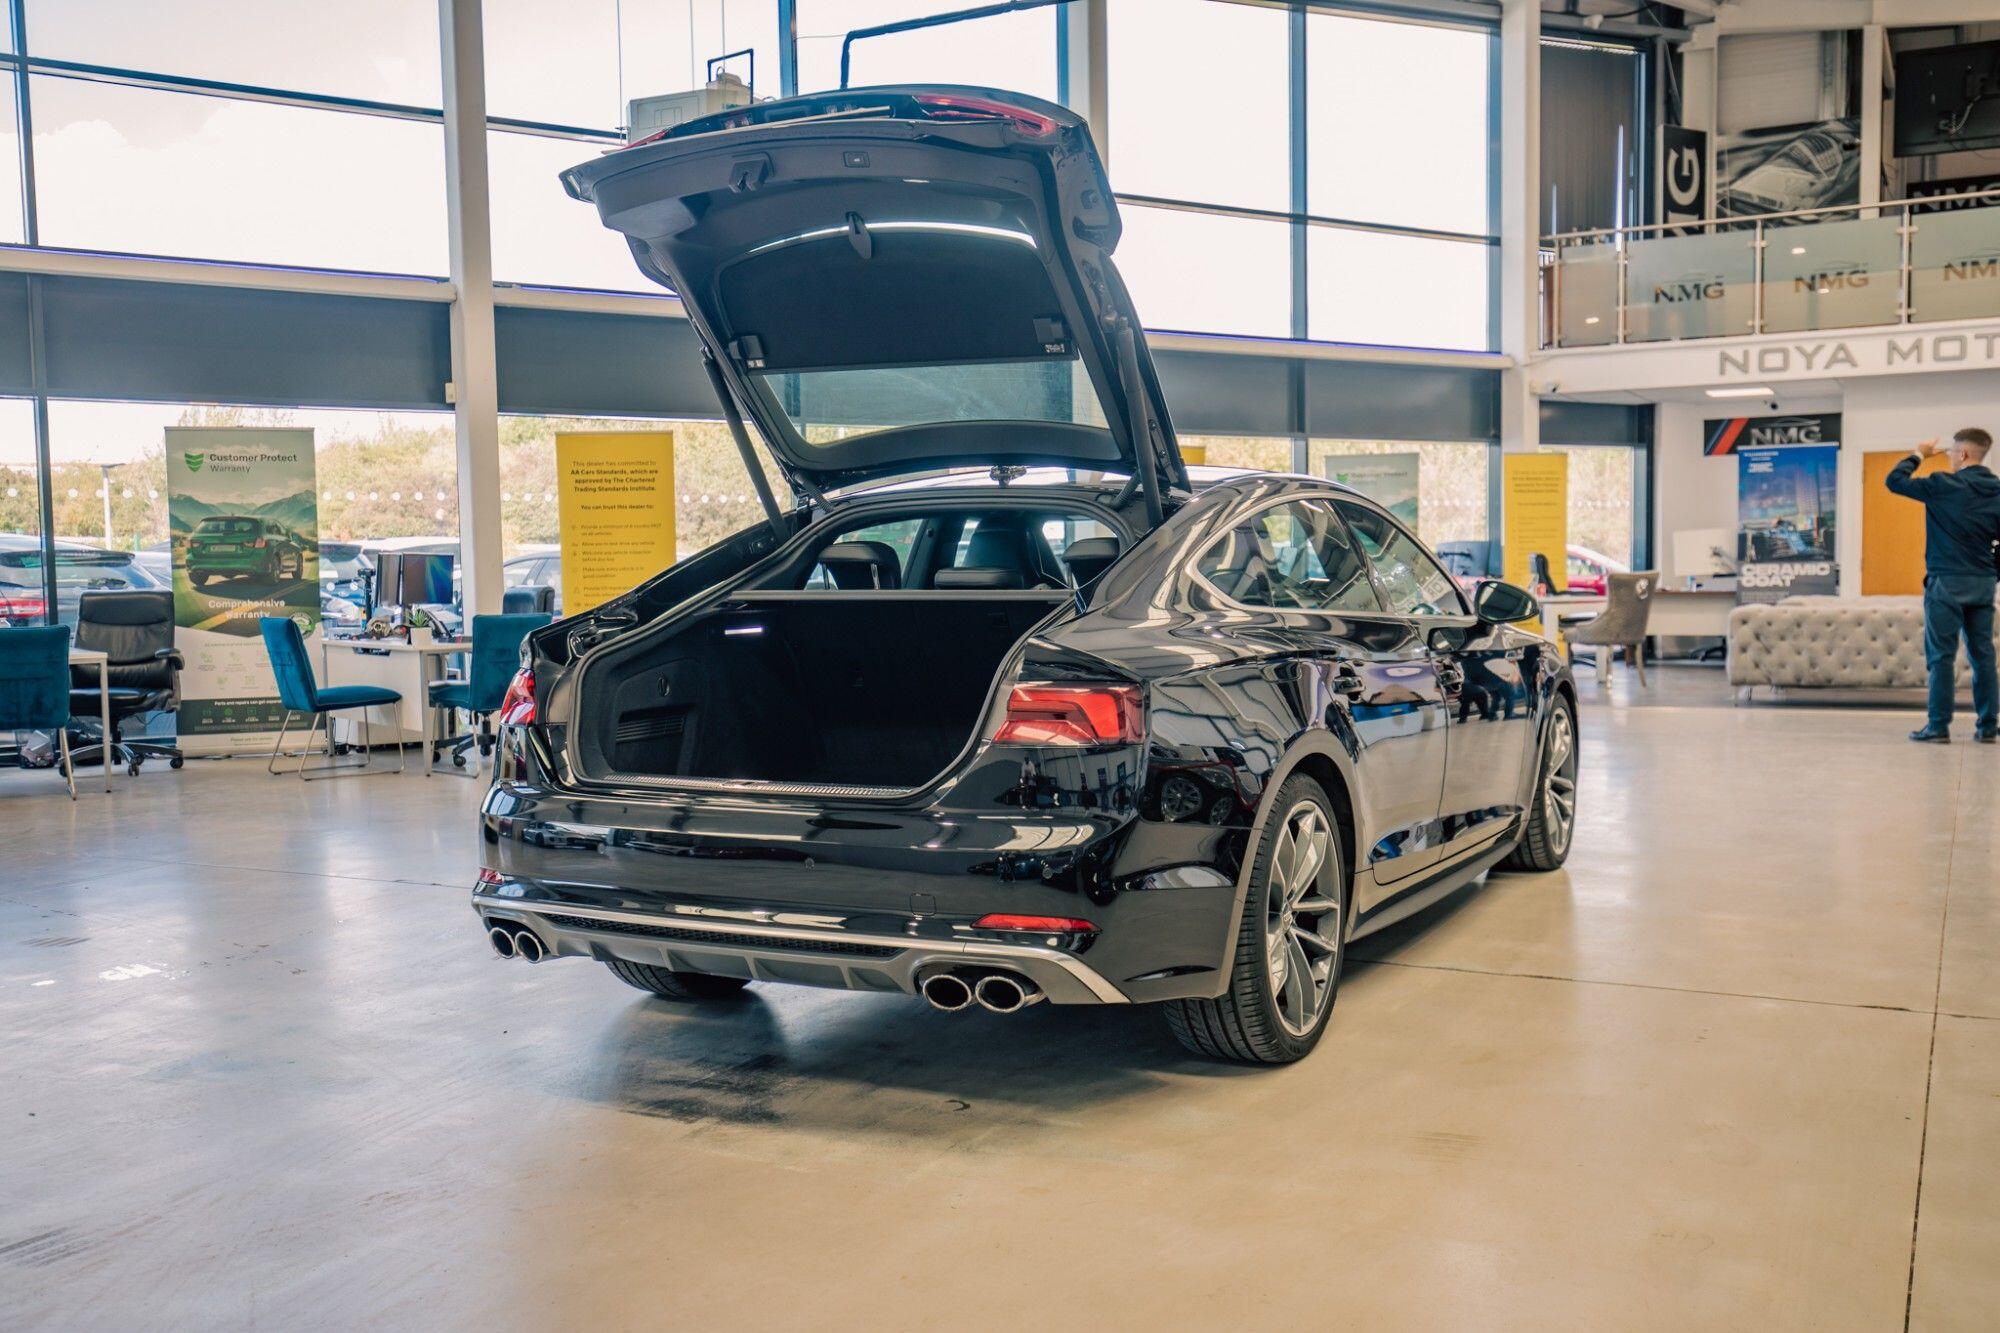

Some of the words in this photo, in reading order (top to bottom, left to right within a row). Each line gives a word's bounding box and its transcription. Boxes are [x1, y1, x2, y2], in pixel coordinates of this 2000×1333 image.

[1944, 258, 2000, 281] NM
[1655, 281, 1725, 303] NMG
[1795, 270, 1869, 293] NMG
[1719, 343, 1858, 376] NOYA
[1887, 333, 2000, 366] MOT
[1750, 425, 1821, 446] NMG
[210, 453, 258, 461] Customer
[260, 453, 297, 461] Protect
[210, 465, 251, 473] Warranty
[208, 598, 285, 609] Comprehensive
